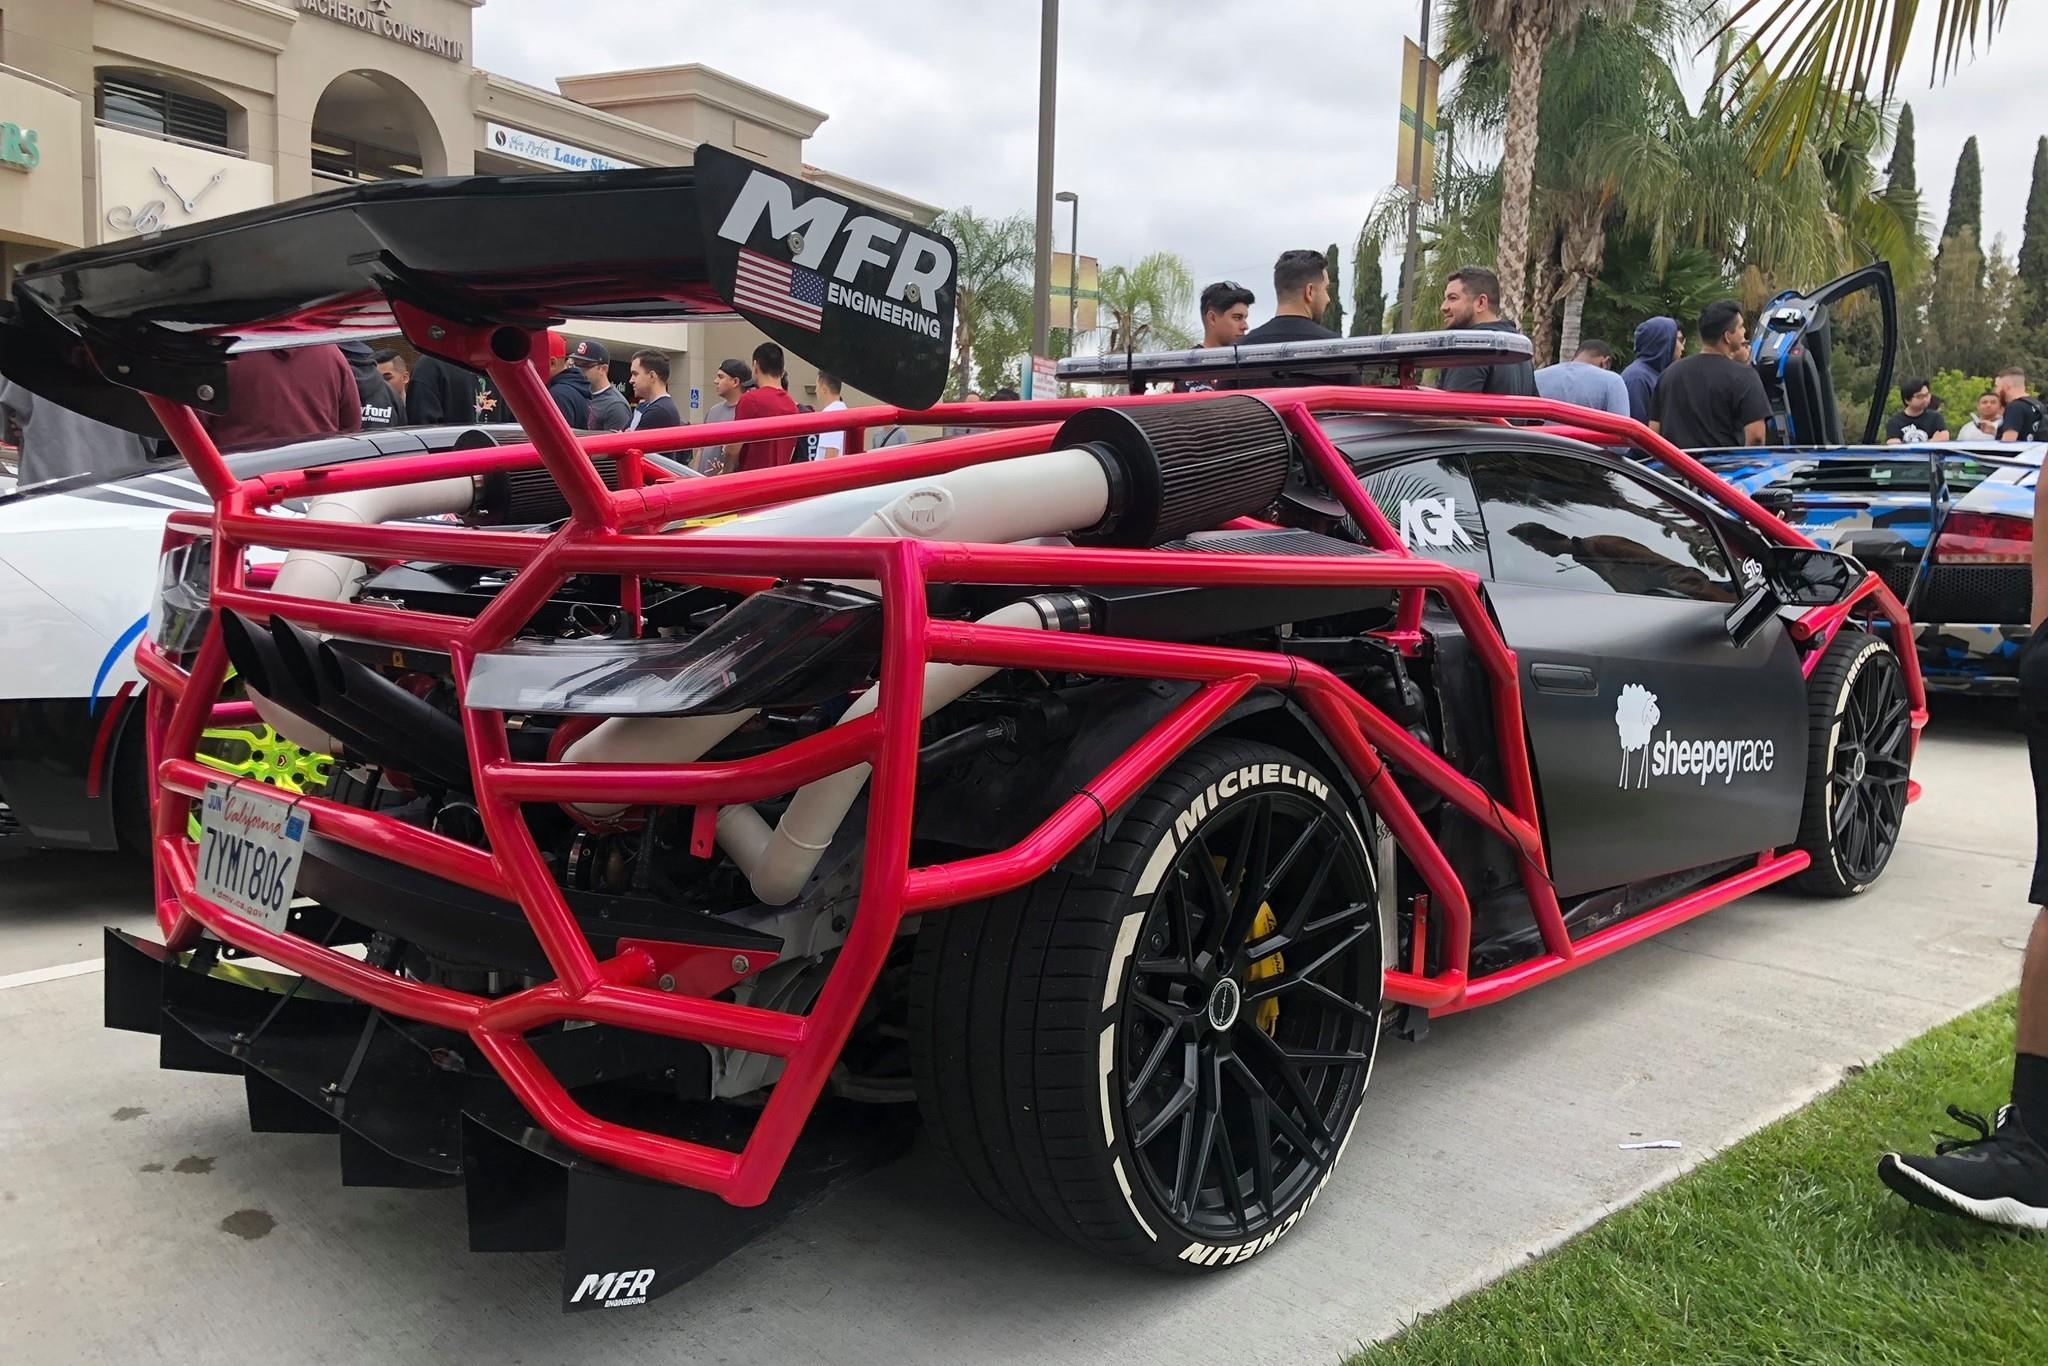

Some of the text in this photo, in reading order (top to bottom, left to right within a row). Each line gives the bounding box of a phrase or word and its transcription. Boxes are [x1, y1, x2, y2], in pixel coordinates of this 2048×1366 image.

[383, 17, 465, 59] CONSTANTIN
[554, 147, 588, 168] Laser
[717, 169, 953, 314] MFR
[828, 282, 941, 339] ENGINEERING
[1847, 641, 1890, 685] MICHELIN
[1651, 730, 1775, 786] sheepeyrace
[208, 794, 223, 811] JUN
[223, 796, 284, 840] California
[1174, 763, 1329, 844] MICHELIN
[204, 826, 293, 911] 7YMT806
[570, 1269, 656, 1303] MFR
